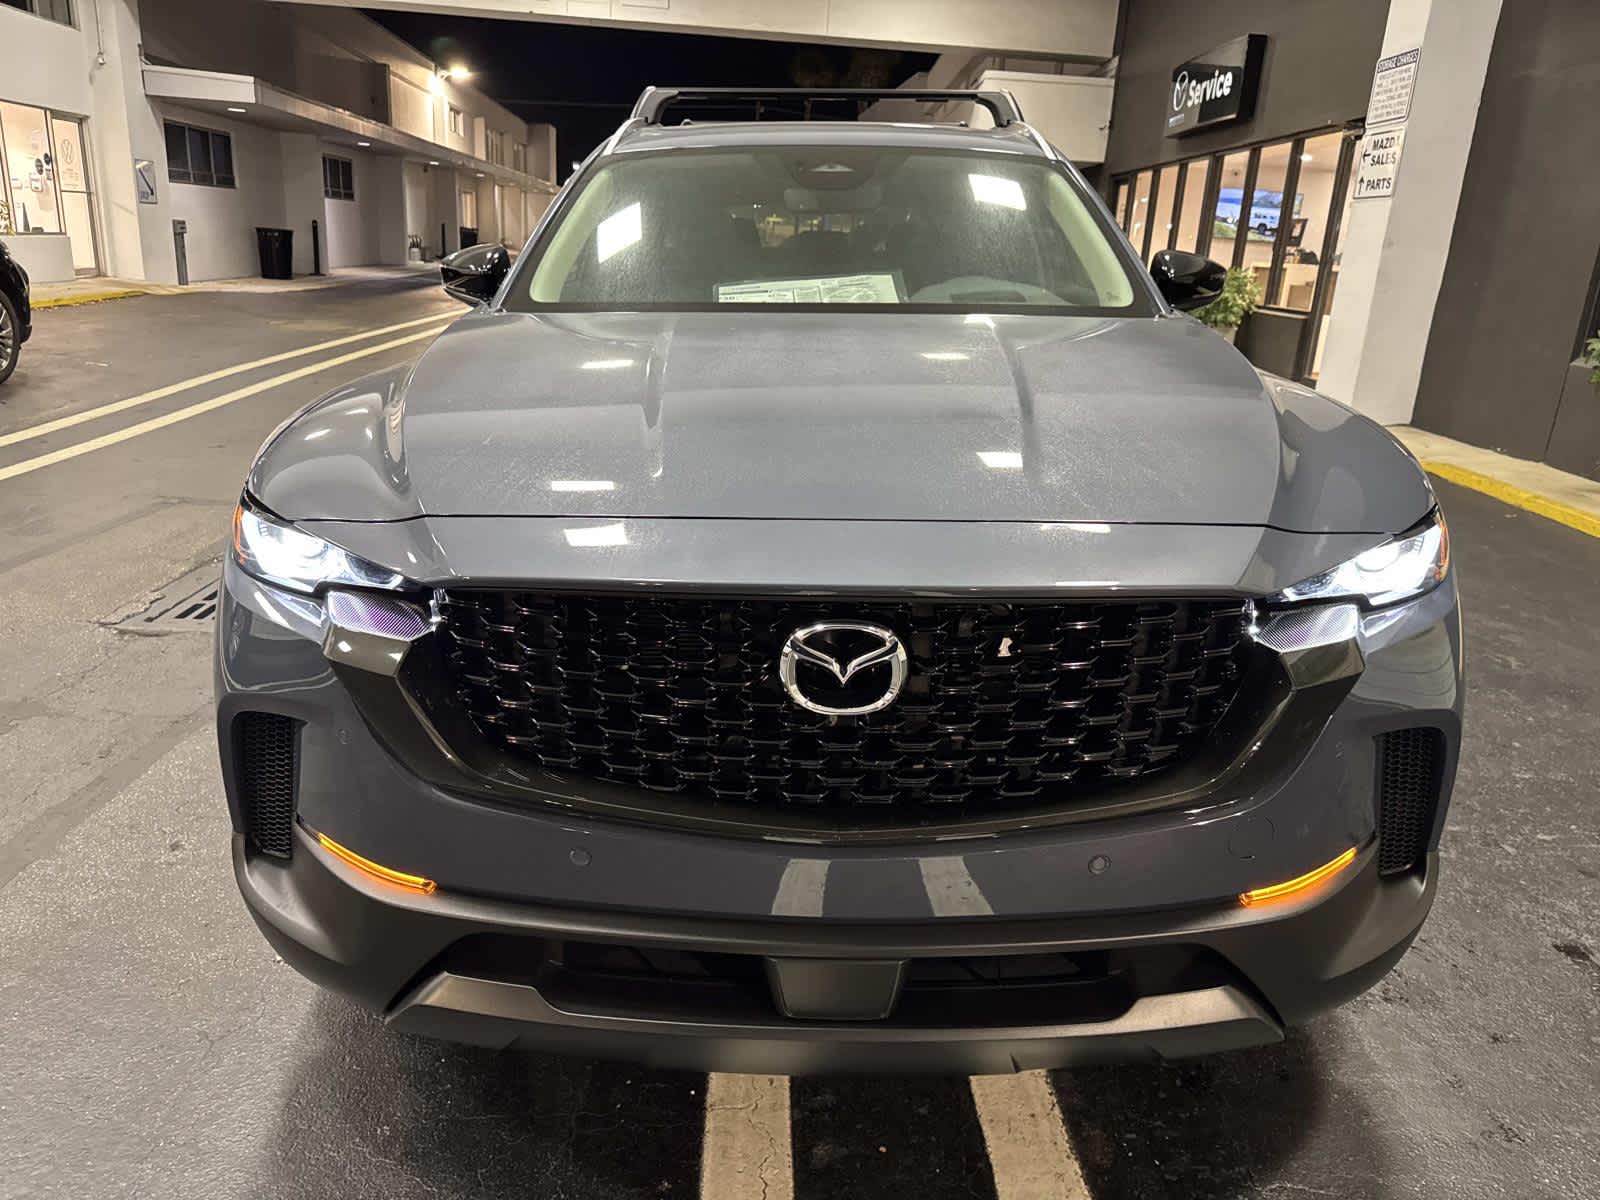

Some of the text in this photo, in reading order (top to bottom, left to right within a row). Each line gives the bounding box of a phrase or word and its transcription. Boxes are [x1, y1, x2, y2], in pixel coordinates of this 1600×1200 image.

[1187, 69, 1233, 108] Service
[1370, 152, 1397, 167] SALES
[1365, 177, 1392, 191] PARTS
